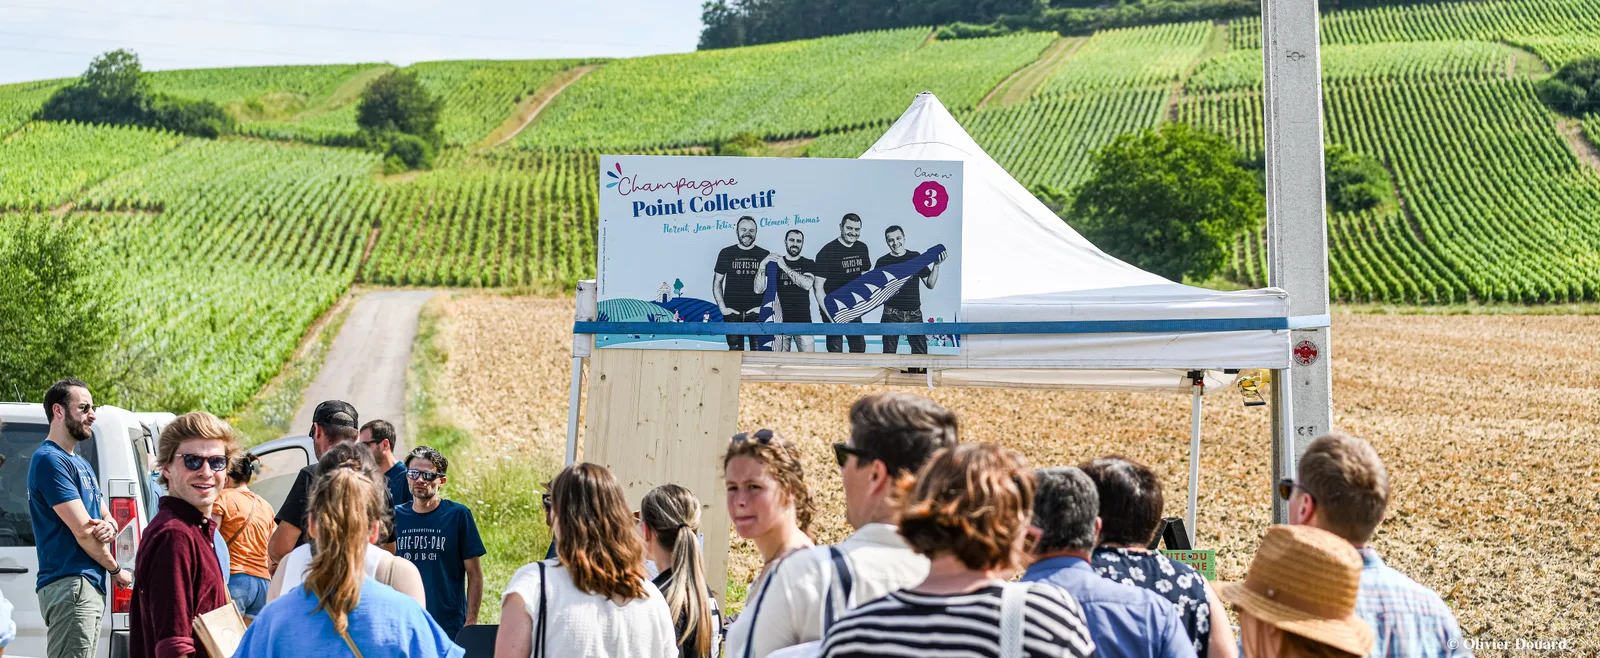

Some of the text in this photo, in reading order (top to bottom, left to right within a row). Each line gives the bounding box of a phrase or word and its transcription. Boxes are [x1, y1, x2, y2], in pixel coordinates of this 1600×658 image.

[914, 167, 939, 178] Cave
[618, 174, 738, 196] Champagne
[632, 189, 776, 218] Point Collectif
[923, 188, 938, 208] 3
[793, 214, 820, 225] Thomas
[1191, 552, 1207, 561] DU
[1185, 562, 1207, 570] NE
